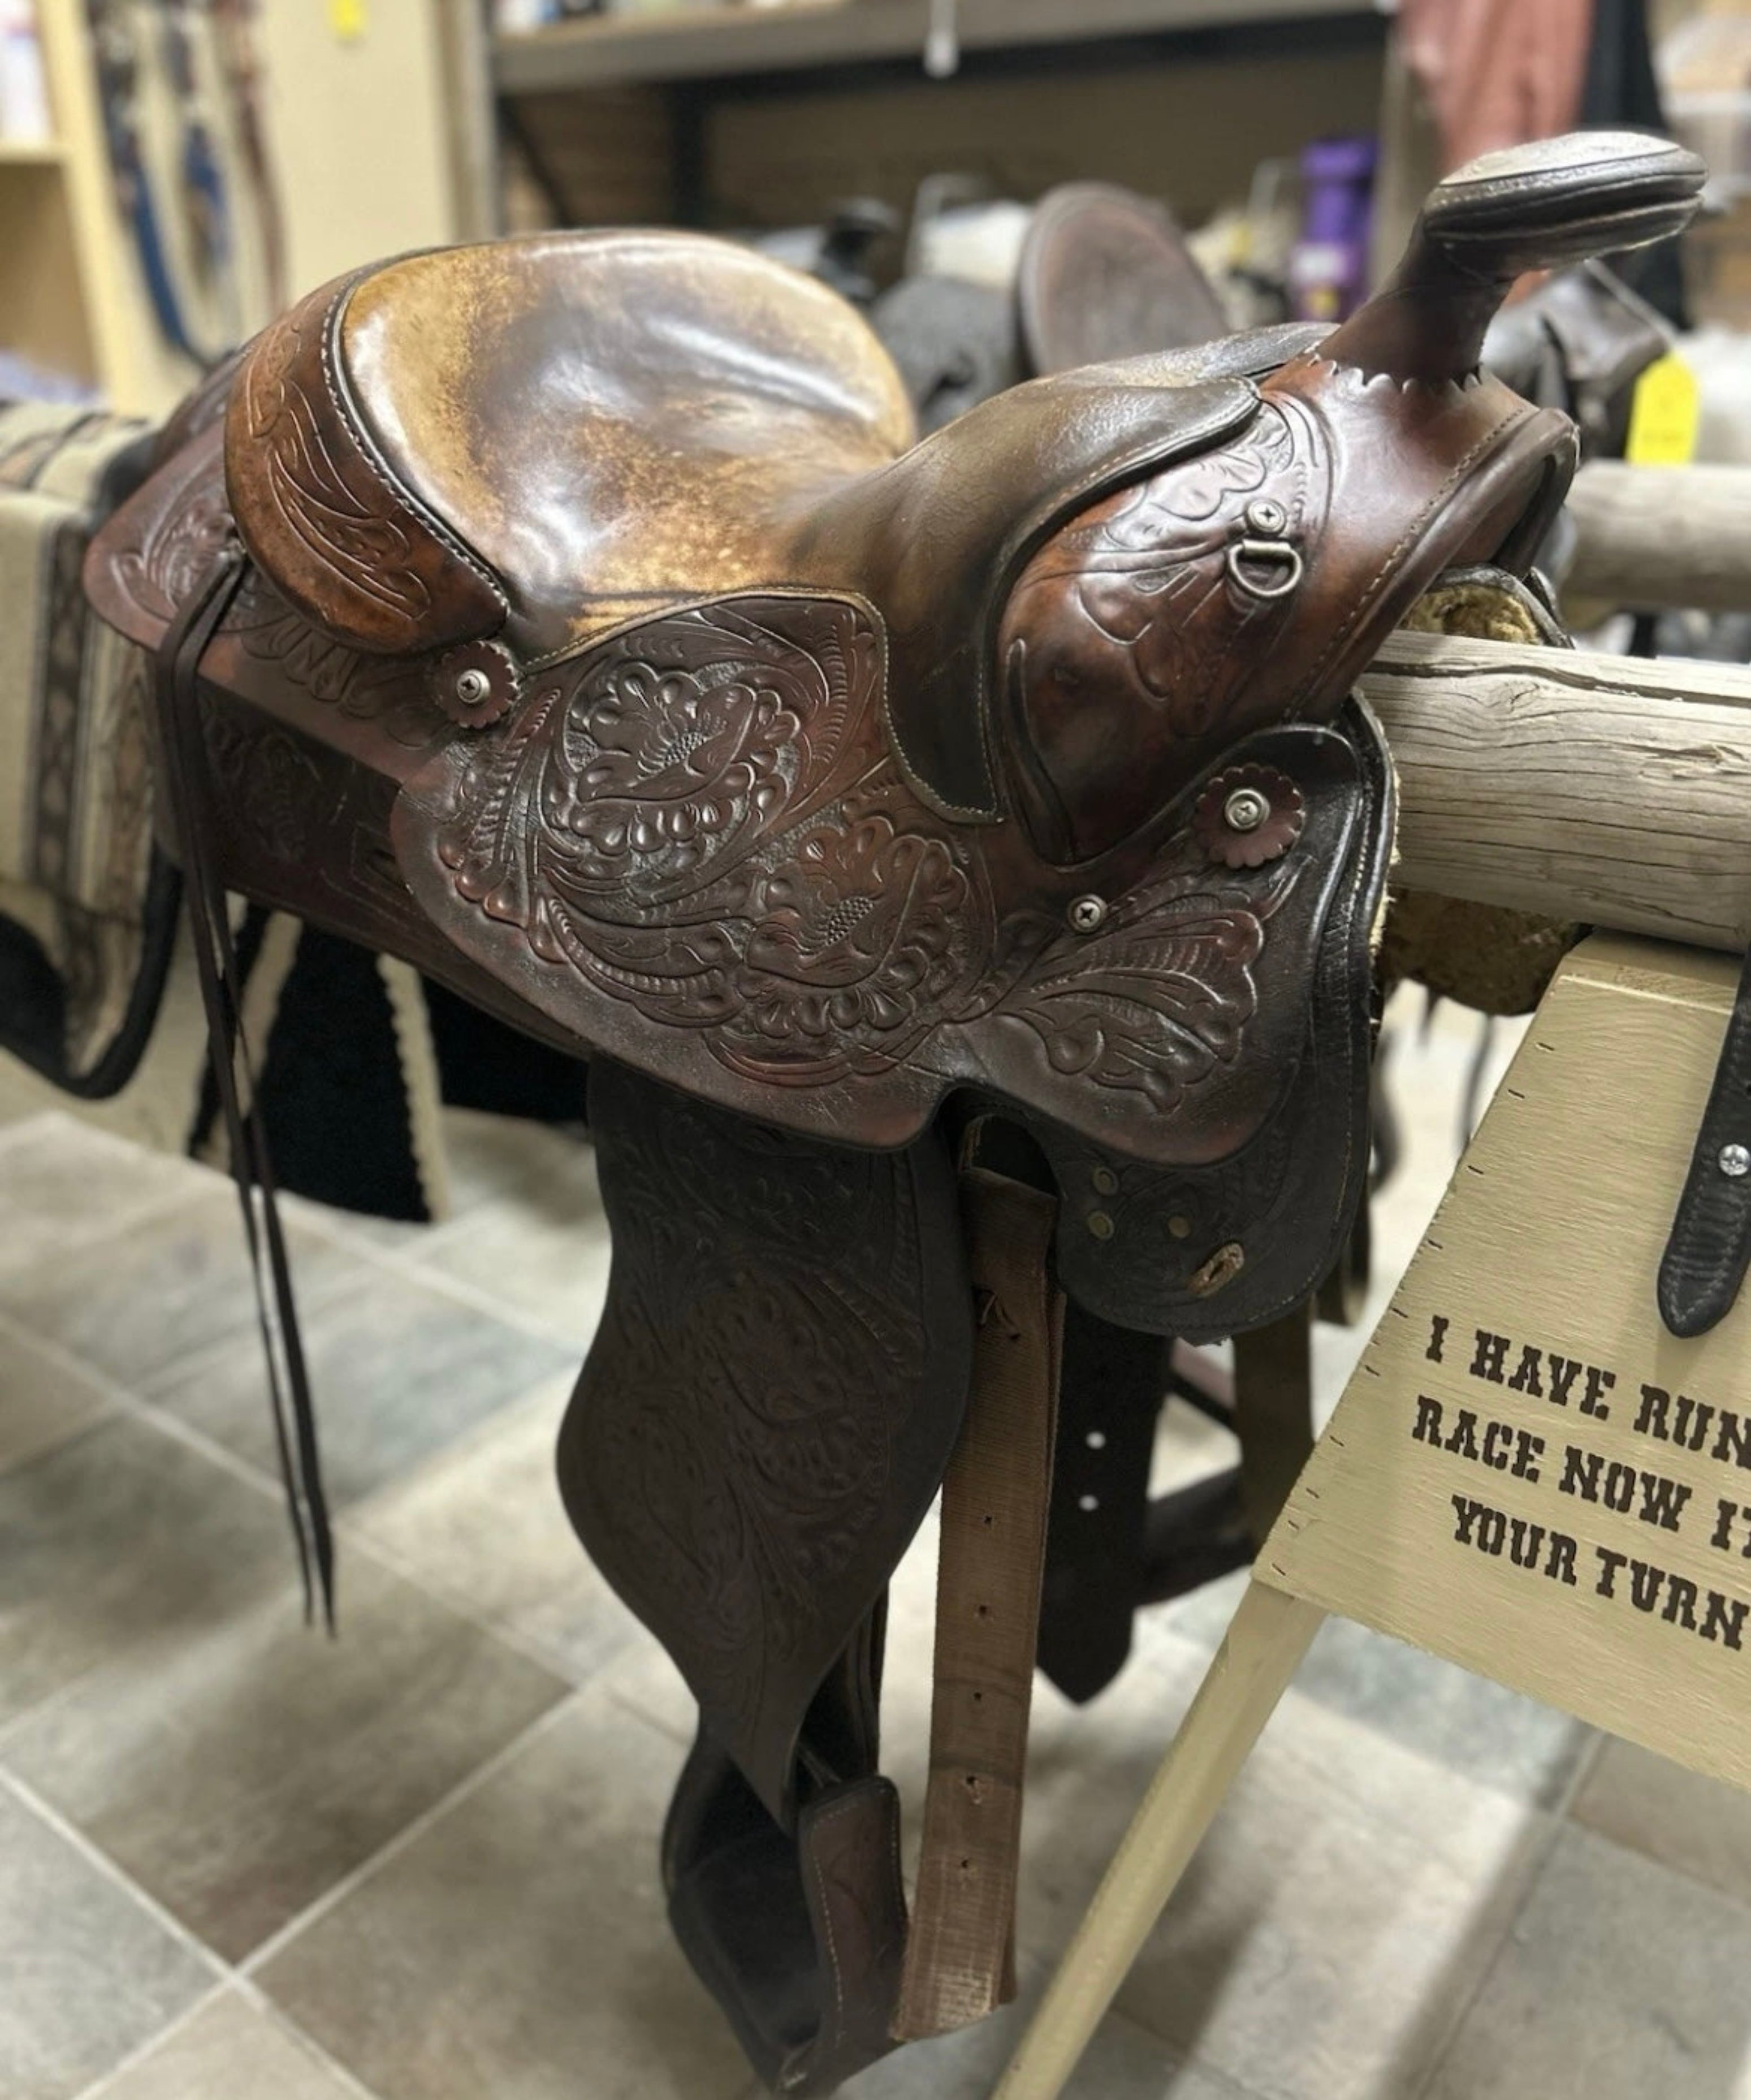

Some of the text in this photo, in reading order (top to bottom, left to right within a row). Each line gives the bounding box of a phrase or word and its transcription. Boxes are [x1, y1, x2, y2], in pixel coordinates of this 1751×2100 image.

[1425, 1315, 1751, 1471] I HAVE RUN
[1412, 1394, 1751, 1559] RACE NOW I
[1451, 1494, 1750, 1651] YOUR TURN
